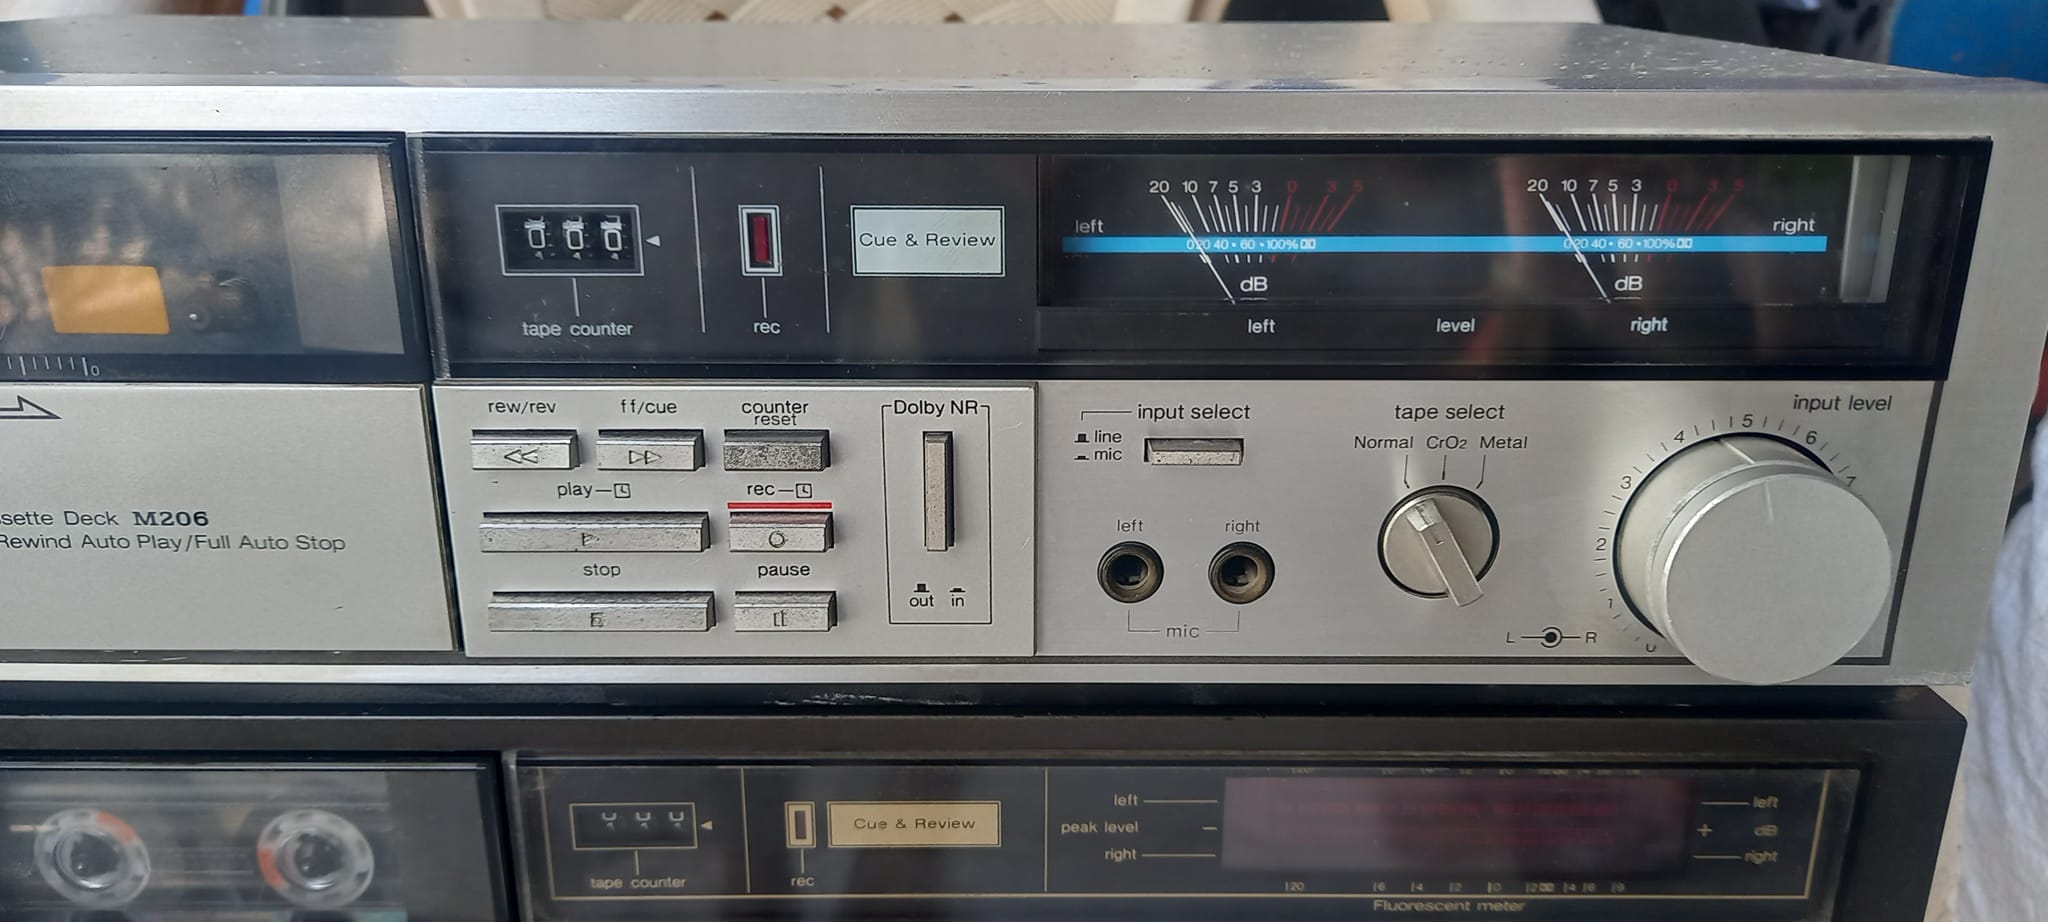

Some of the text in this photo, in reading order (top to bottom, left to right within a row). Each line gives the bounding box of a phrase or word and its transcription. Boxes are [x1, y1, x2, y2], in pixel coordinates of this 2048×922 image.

[1149, 180, 1170, 193] 20
[1182, 180, 1198, 193] 10
[1209, 180, 1218, 193] 7
[1228, 180, 1239, 193] 5
[1251, 180, 1262, 193] 3
[1287, 180, 1298, 193] 0
[1527, 179, 1548, 192] 20
[1561, 179, 1577, 192] 10
[1588, 179, 1598, 192] 7
[1608, 179, 1619, 192] 5
[1631, 179, 1642, 192] 3
[1075, 219, 1104, 234] left
[1772, 218, 1815, 235] right
[859, 232, 995, 247] Cue & Review
[1213, 239, 1229, 250] 40
[1240, 239, 1255, 250] 60
[1591, 238, 1607, 249] 40
[1617, 238, 1633, 249] 60
[1240, 276, 1268, 292] dB
[1614, 276, 1643, 291] dB
[522, 320, 633, 337] tape counter
[753, 320, 781, 334] rec
[1248, 318, 1276, 334] left
[1436, 317, 1475, 334] level
[1630, 317, 1668, 335] right
[488, 401, 556, 415] rew/rev
[621, 400, 677, 415] ff/cue
[742, 401, 809, 415] counter
[893, 400, 978, 417] Dolby NR
[1793, 394, 1892, 413] input level
[1137, 404, 1251, 421] input select
[1395, 404, 1505, 421] tape select
[754, 414, 798, 427] reset
[1742, 414, 1753, 428] 5
[1094, 430, 1122, 443] line
[1354, 436, 1414, 449] Normal
[1479, 436, 1528, 449] Metal
[1674, 430, 1685, 443] 4
[1806, 431, 1817, 445] 6
[1094, 448, 1122, 461] mic
[1620, 475, 1632, 490] 3
[557, 483, 593, 499] play
[747, 483, 775, 497] rec
[0, 511, 209, 527] sette Deck M206
[1117, 519, 1144, 532] left
[1225, 519, 1261, 534] right
[0, 534, 72, 549] Rewind
[81, 534, 130, 549] Auto
[239, 535, 288, 550] Auto
[296, 535, 346, 552] Stop
[1596, 538, 1607, 551] 2
[583, 563, 621, 578] stop
[758, 564, 810, 579] pause
[909, 594, 965, 607] out in
[1608, 598, 1614, 608] 1
[1166, 624, 1200, 638] mic
[1506, 632, 1515, 643] L
[1585, 632, 1597, 643] R
[1114, 794, 1138, 807] left
[1753, 796, 1778, 809] left
[854, 818, 976, 830] Cue & Review
[1061, 822, 1139, 835] peak level
[1104, 848, 1137, 862] right
[1744, 850, 1778, 864] right
[591, 876, 687, 890] tape counter
[791, 875, 815, 887] rec
[1373, 899, 1526, 912] Fluorescent meter
